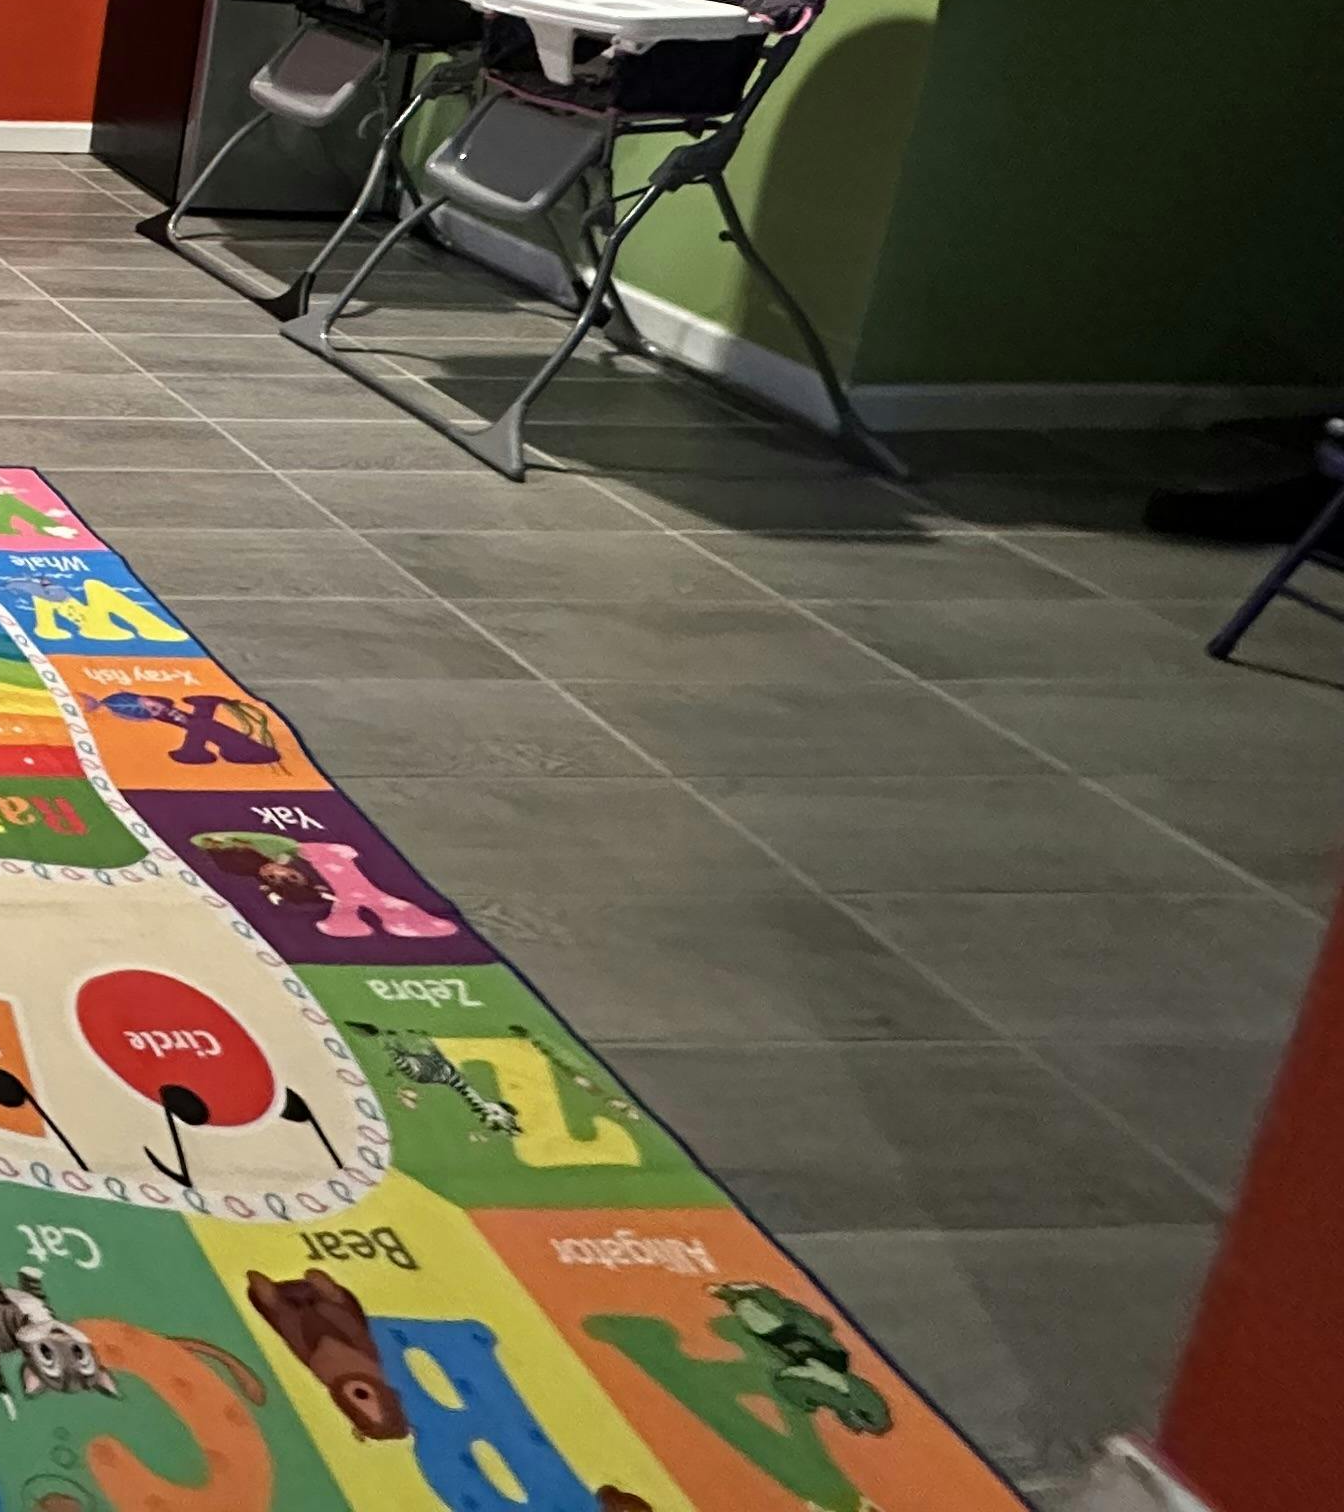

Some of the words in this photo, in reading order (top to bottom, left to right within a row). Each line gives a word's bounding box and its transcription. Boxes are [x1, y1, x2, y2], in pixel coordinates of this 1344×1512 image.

[8, 553, 92, 573] Whale
[33, 578, 190, 642] W
[250, 805, 325, 830] Yak
[366, 978, 484, 1009] Zebra
[123, 1027, 224, 1059] Circle
[431, 1035, 643, 1170] Z
[16, 1222, 105, 1271] Cat
[303, 1226, 422, 1272] Bear
[550, 1232, 719, 1274] Alligator
